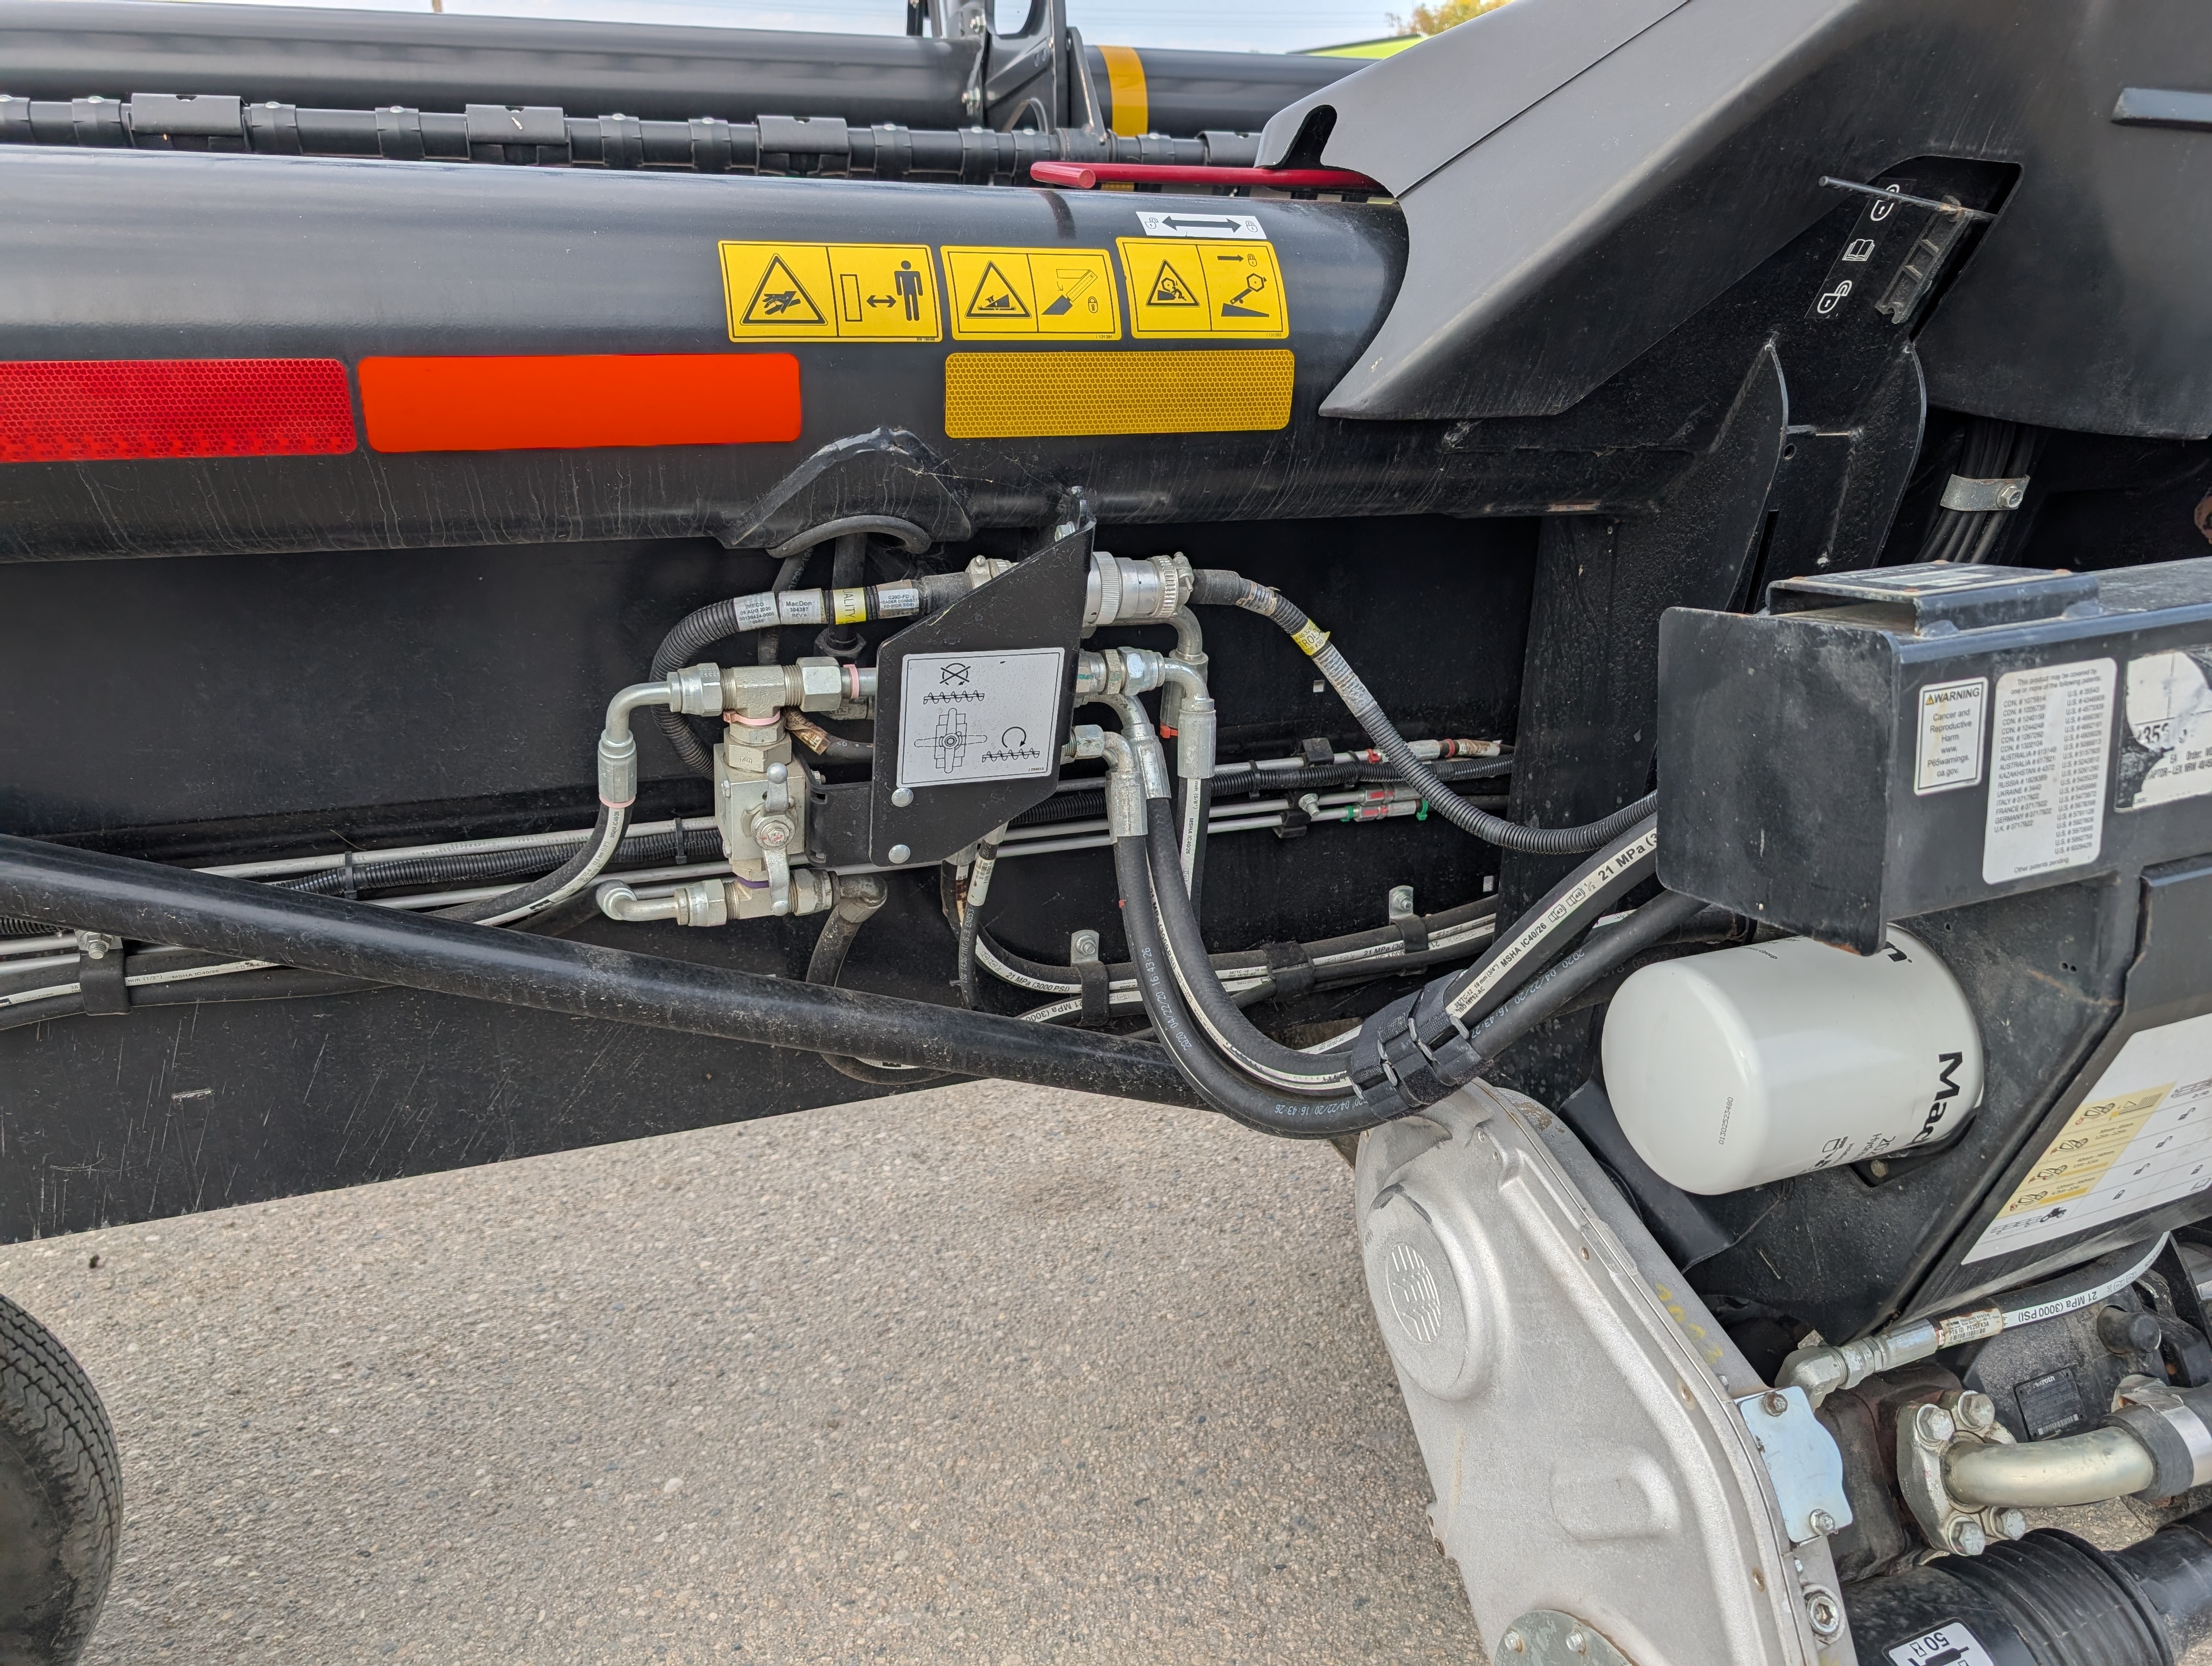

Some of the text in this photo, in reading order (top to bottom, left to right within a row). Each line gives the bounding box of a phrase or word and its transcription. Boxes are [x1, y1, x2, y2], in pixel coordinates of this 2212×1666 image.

[1934, 687, 1979, 703] WARNING
[1933, 708, 1970, 721] Cancer and
[1930, 721, 1971, 733] Reproductive
[1927, 754, 1969, 767] P65warnings.
[1999, 751, 2031, 761] AUSTRALIA
[2187, 751, 2202, 760] Order:
[1999, 760, 2030, 770] AUSTRALIA
[1937, 768, 1959, 777] ca.gov.
[1998, 767, 2036, 779] KAZAKHSTAN
[1195, 781, 1198, 791] mm
[1998, 779, 2019, 788] RUSSIA
[1997, 787, 2022, 797] UKRAINE
[1996, 805, 2019, 815] FRANCE
[1995, 813, 2023, 824] GERMANY
[599, 851, 604, 859] mm
[1480, 975, 1488, 984] mm
[1487, 964, 1500, 977] (3/4")
[1500, 946, 1522, 967] MSHA
[1521, 922, 1547, 948] IC40/26
[1598, 866, 1614, 881] 21
[1615, 845, 1645, 867] MPa
[194, 969, 220, 977] IC40/26
[1015, 976, 1031, 986] MPa
[1032, 981, 1052, 991] (3000
[1142, 947, 1192, 1050] 2020 04/22/20 16:43:26
[1471, 949, 1585, 1039] 2020 04/22/20 16:43:27
[1052, 1003, 1071, 1013] MPa
[1075, 1000, 1082, 1009] 21
[1207, 1027, 1218, 1042] KOREA
[1275, 1100, 1349, 1116] 04/22/20 16:43:26
[1718, 1097, 1733, 1145] 01302523480
[2018, 1291, 2097, 1322] 21 MPa (3000 PSI)
[1924, 1632, 1950, 1651] 50
